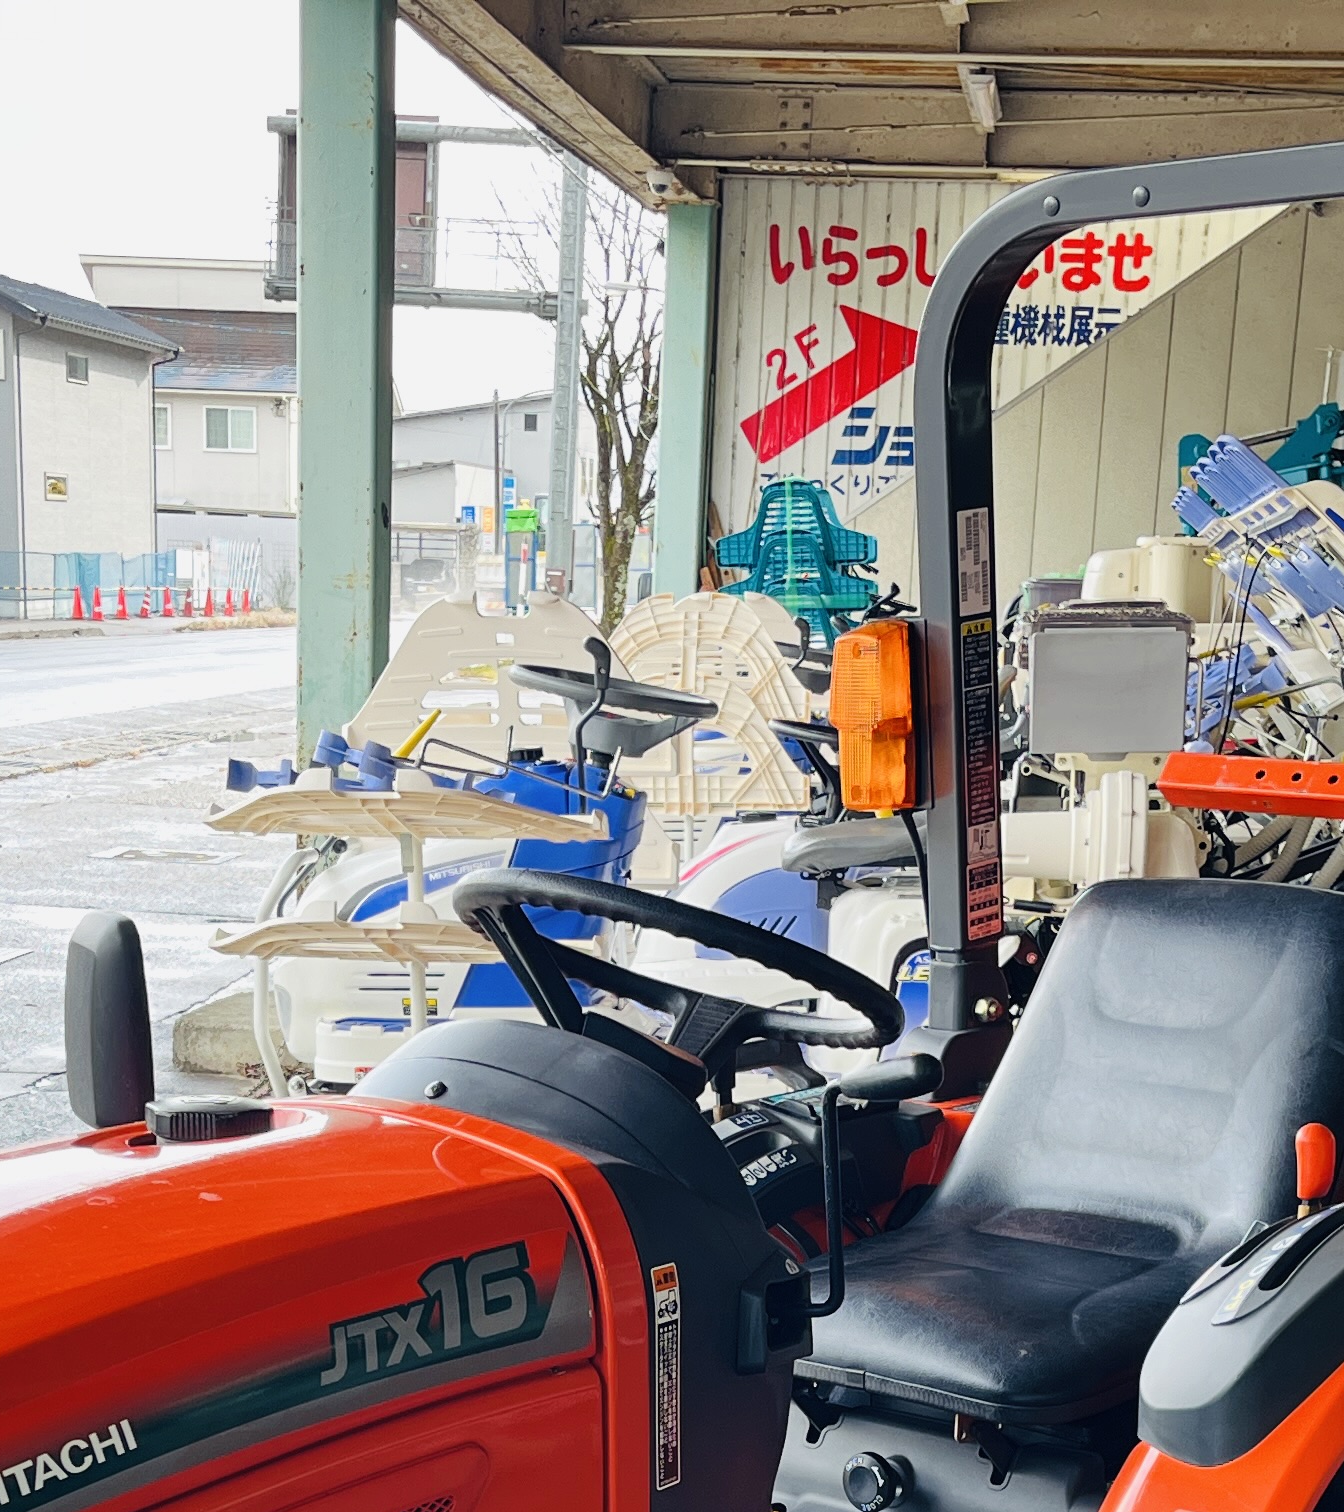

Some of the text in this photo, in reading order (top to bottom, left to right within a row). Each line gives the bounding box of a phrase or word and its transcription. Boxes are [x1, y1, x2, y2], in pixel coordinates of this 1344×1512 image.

[769, 223, 1153, 293] いらっしいませ
[766, 323, 820, 391] 2F
[320, 1241, 533, 1387] JTX16
